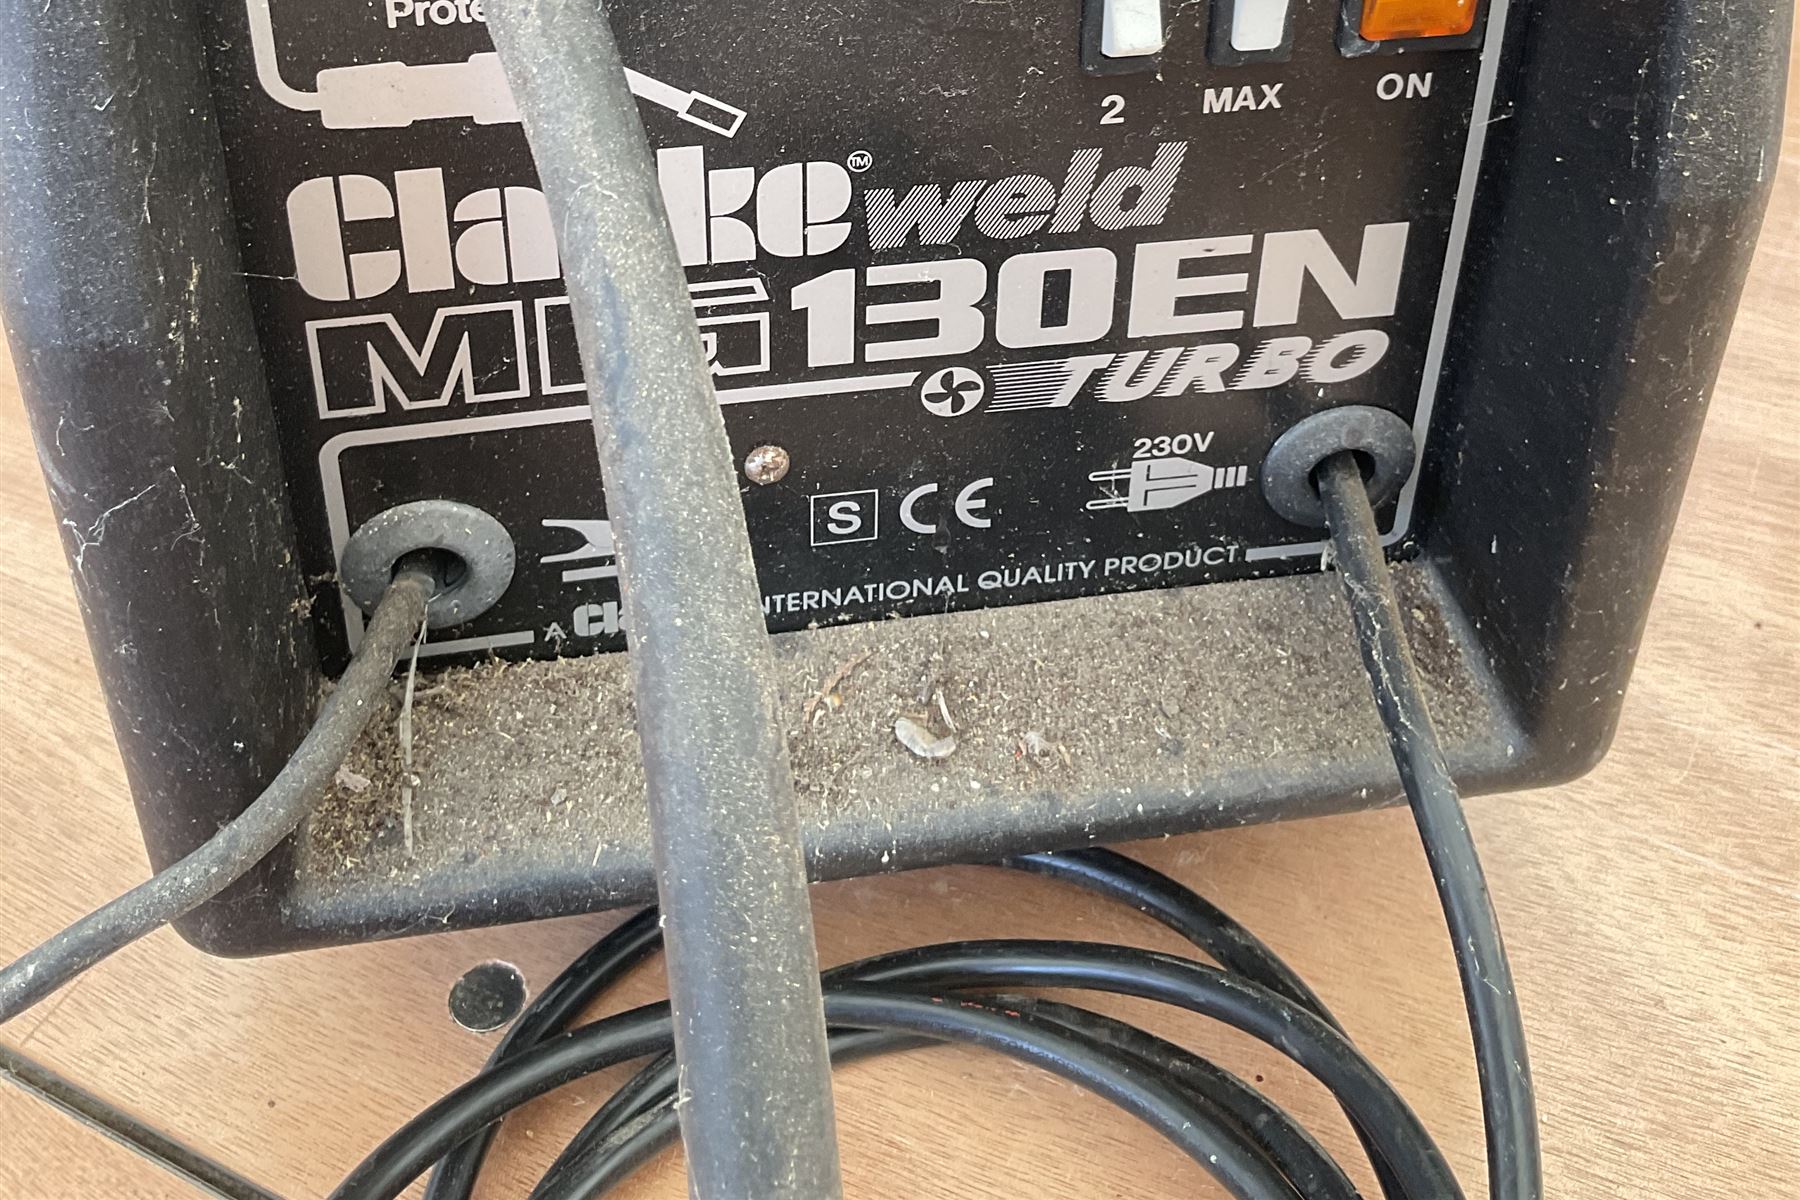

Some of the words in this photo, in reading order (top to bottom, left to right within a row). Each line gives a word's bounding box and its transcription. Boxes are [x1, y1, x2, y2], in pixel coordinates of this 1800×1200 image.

[1202, 83, 1284, 115] MAX
[1375, 71, 1433, 101] ON
[1100, 94, 1126, 125] 2
[286, 145, 852, 301] Clake
[864, 140, 1188, 250] weld
[791, 221, 1410, 367] 130EN
[1045, 329, 1390, 408] TURBO
[1132, 432, 1215, 459] 230V
[826, 500, 861, 535] S
[900, 477, 994, 534] CE
[977, 559, 1096, 590] QUALITY
[1104, 544, 1239, 576] PRODUCT
